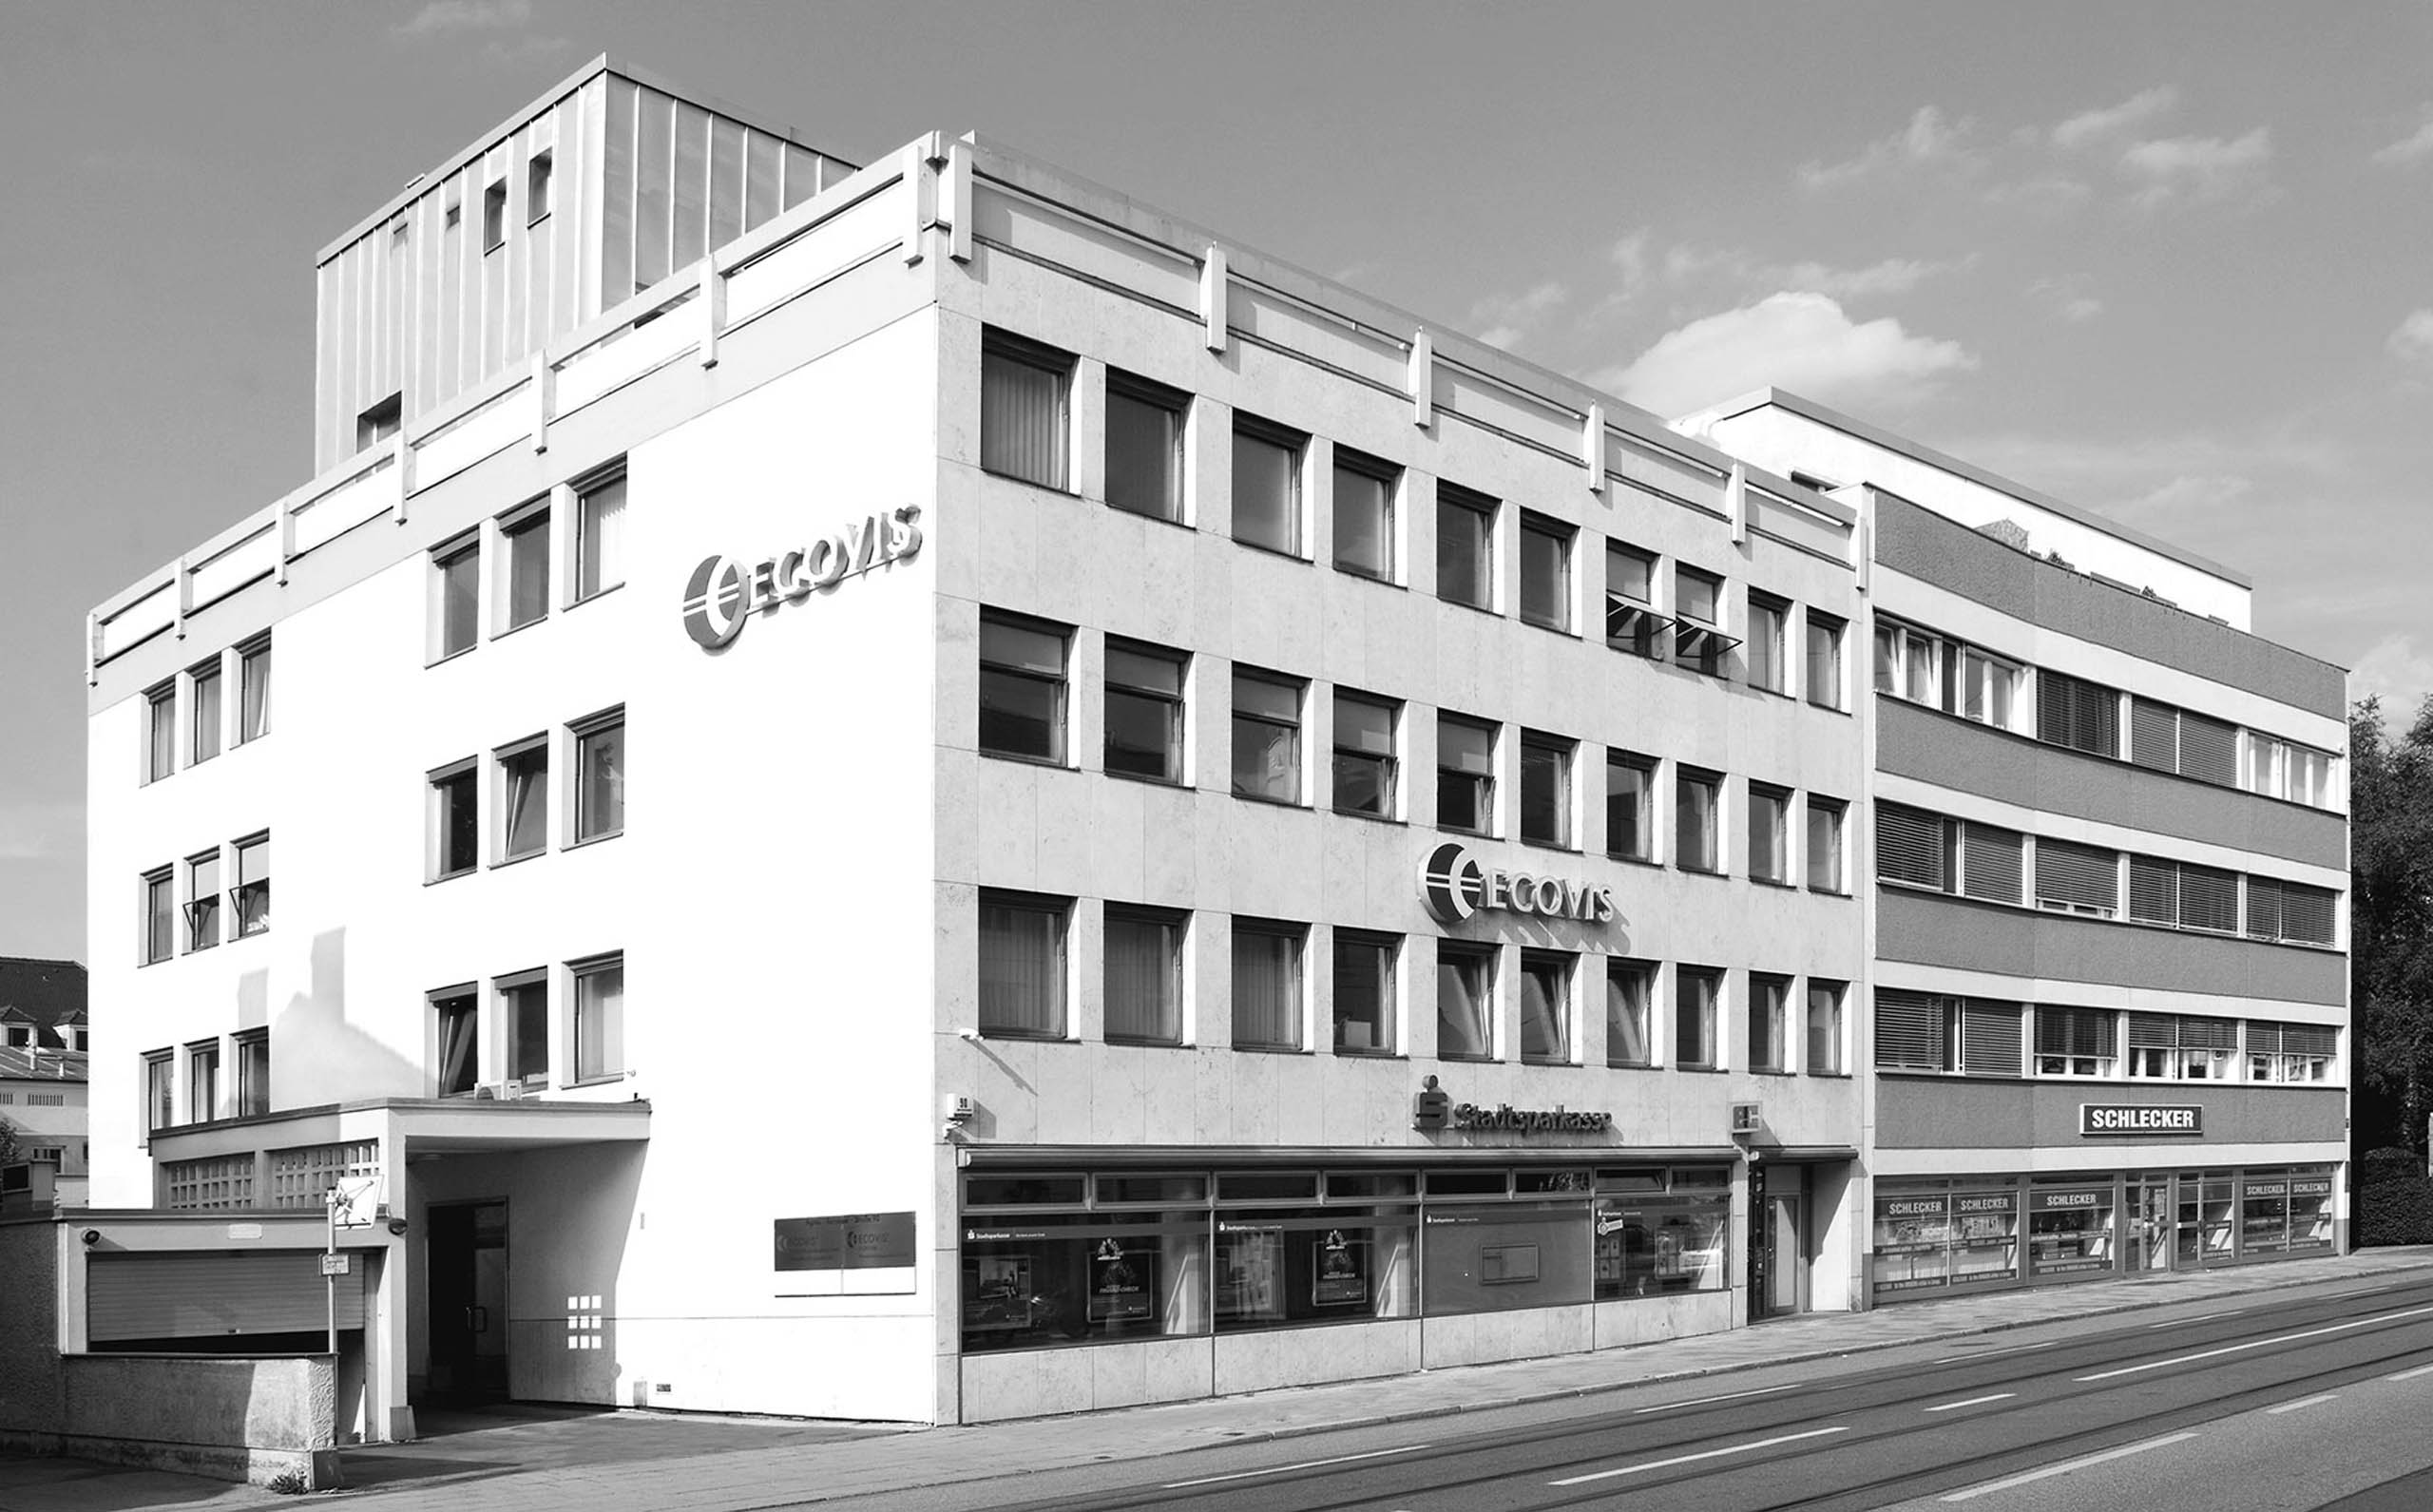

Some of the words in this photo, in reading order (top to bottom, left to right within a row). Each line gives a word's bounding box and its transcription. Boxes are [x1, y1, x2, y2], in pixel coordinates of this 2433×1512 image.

[750, 504, 923, 608] ECOVIS
[1486, 868, 1615, 923] ECOVIS
[1454, 1103, 1612, 1137] Stadtsparkasse
[2092, 1109, 2194, 1128] SCHLECKER
[2246, 1184, 2286, 1196] SCHLECKER
[2293, 1182, 2329, 1194] SCHLECKER
[1961, 1198, 2009, 1211] SCHLECKER
[2046, 1194, 2097, 1207] SCHLECKER
[1888, 1201, 1943, 1215] SCHLECKER
